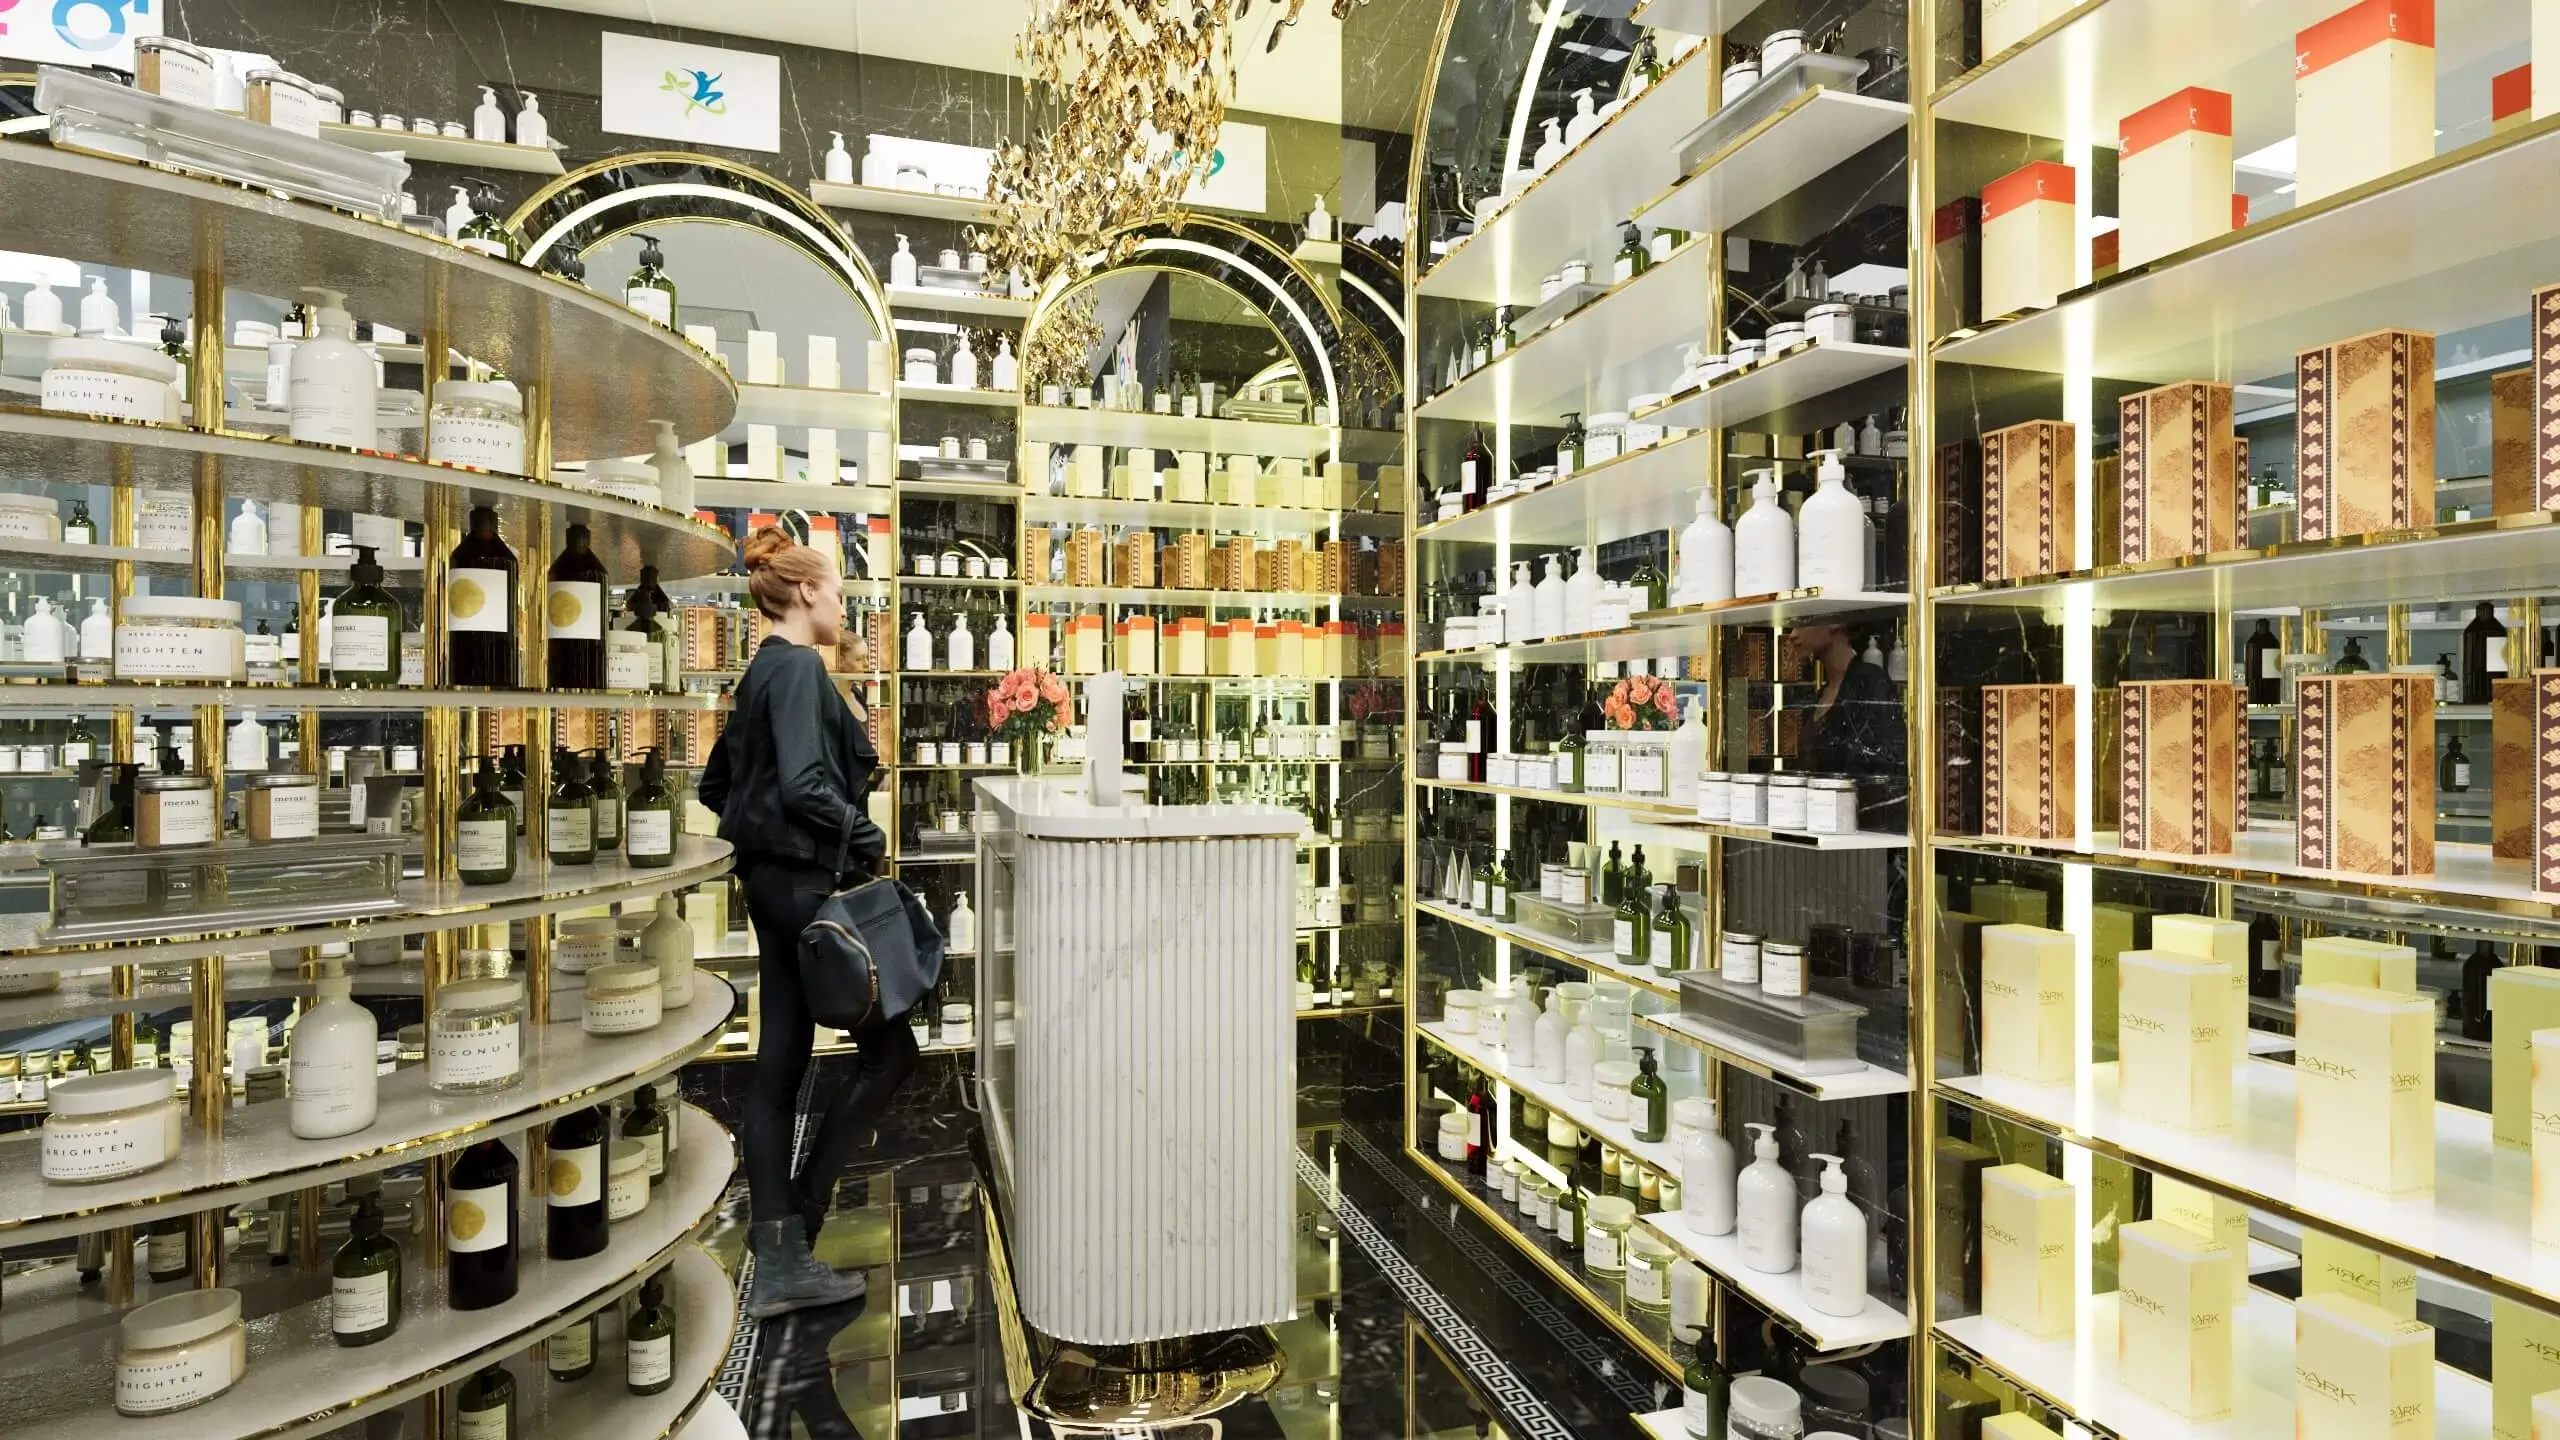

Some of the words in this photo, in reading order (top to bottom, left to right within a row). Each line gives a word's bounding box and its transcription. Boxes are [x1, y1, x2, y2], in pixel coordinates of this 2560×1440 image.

[46, 391, 134, 403] BRIGHTEN
[431, 437, 512, 448] COCONUT
[120, 647, 203, 655] BRIGHTEN
[164, 799, 200, 807] meraki
[274, 795, 308, 803] meraki
[431, 1040, 512, 1057] COCONUT
[46, 1141, 134, 1158] BRIGHTEN
[120, 1370, 203, 1390] BRIGHTEN
